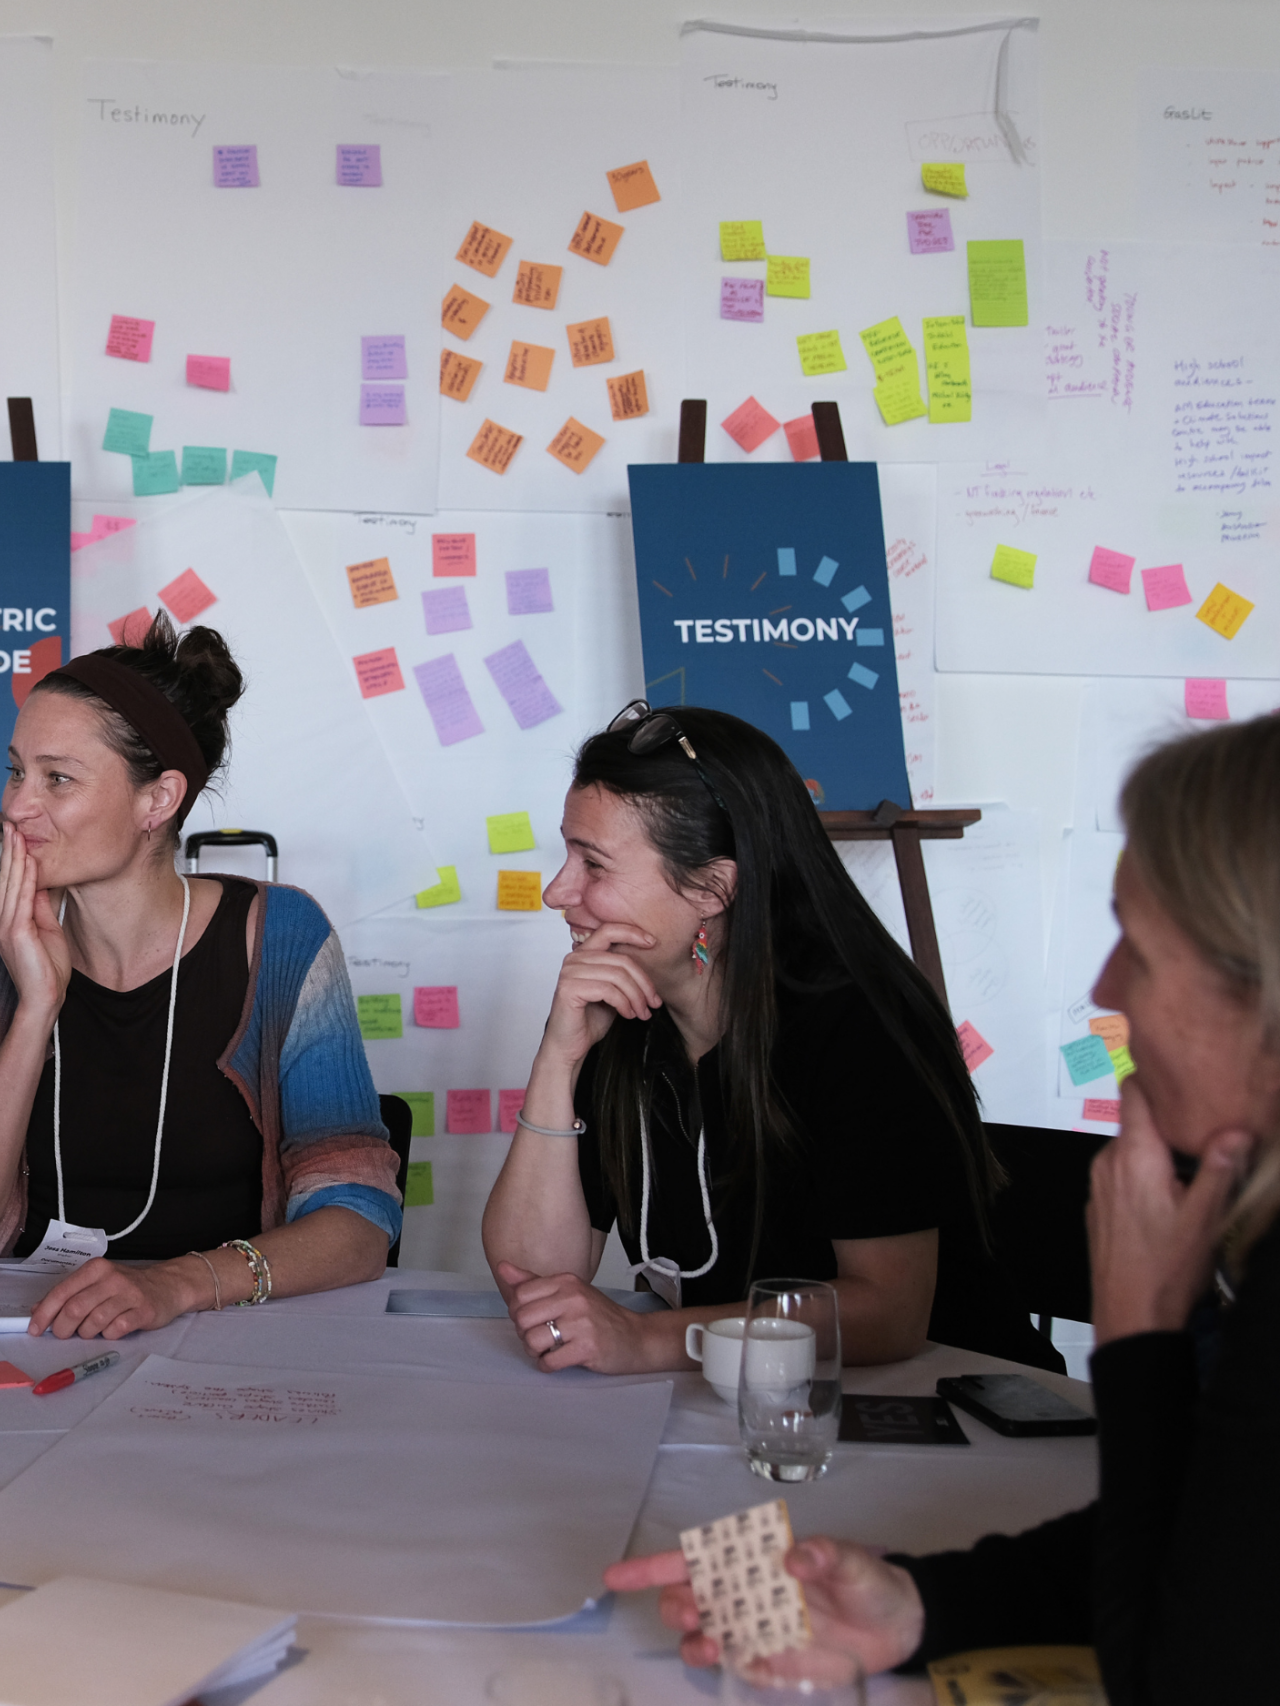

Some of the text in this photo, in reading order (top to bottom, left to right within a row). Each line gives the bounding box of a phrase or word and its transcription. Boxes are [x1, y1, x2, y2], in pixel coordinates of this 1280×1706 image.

[87, 98, 206, 138] Testimony
[673, 617, 860, 644] TESTIMONY
[60, 1247, 91, 1257] Hamilton
[855, 1400, 922, 1438] YES
